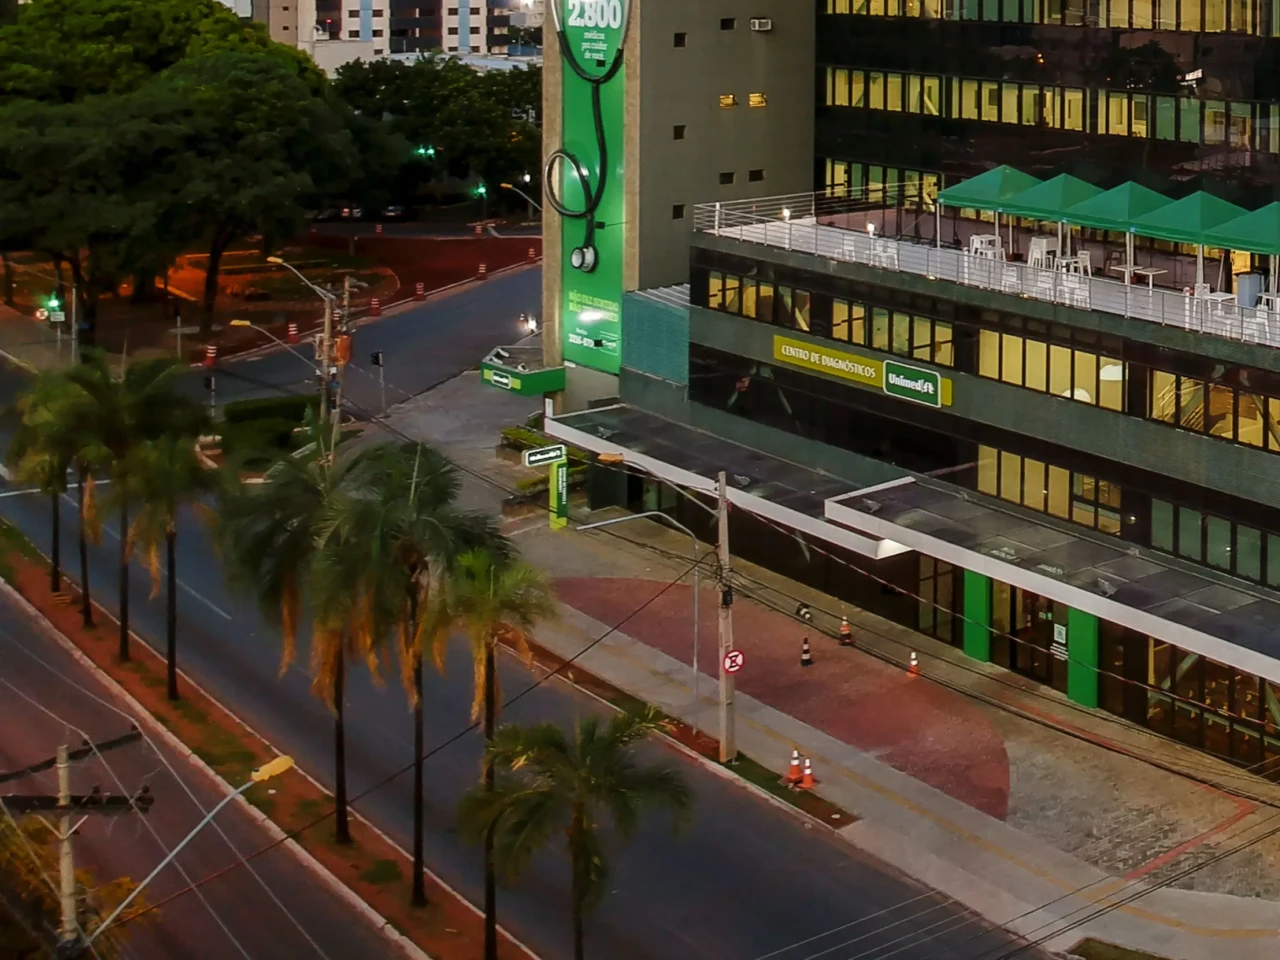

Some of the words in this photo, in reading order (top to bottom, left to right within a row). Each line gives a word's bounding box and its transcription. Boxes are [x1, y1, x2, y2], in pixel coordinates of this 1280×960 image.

[781, 345, 809, 361] CENTRO
[810, 352, 820, 364] DE
[821, 355, 876, 378] DIAGNÓSTICOS
[888, 373, 921, 392] Unimed
